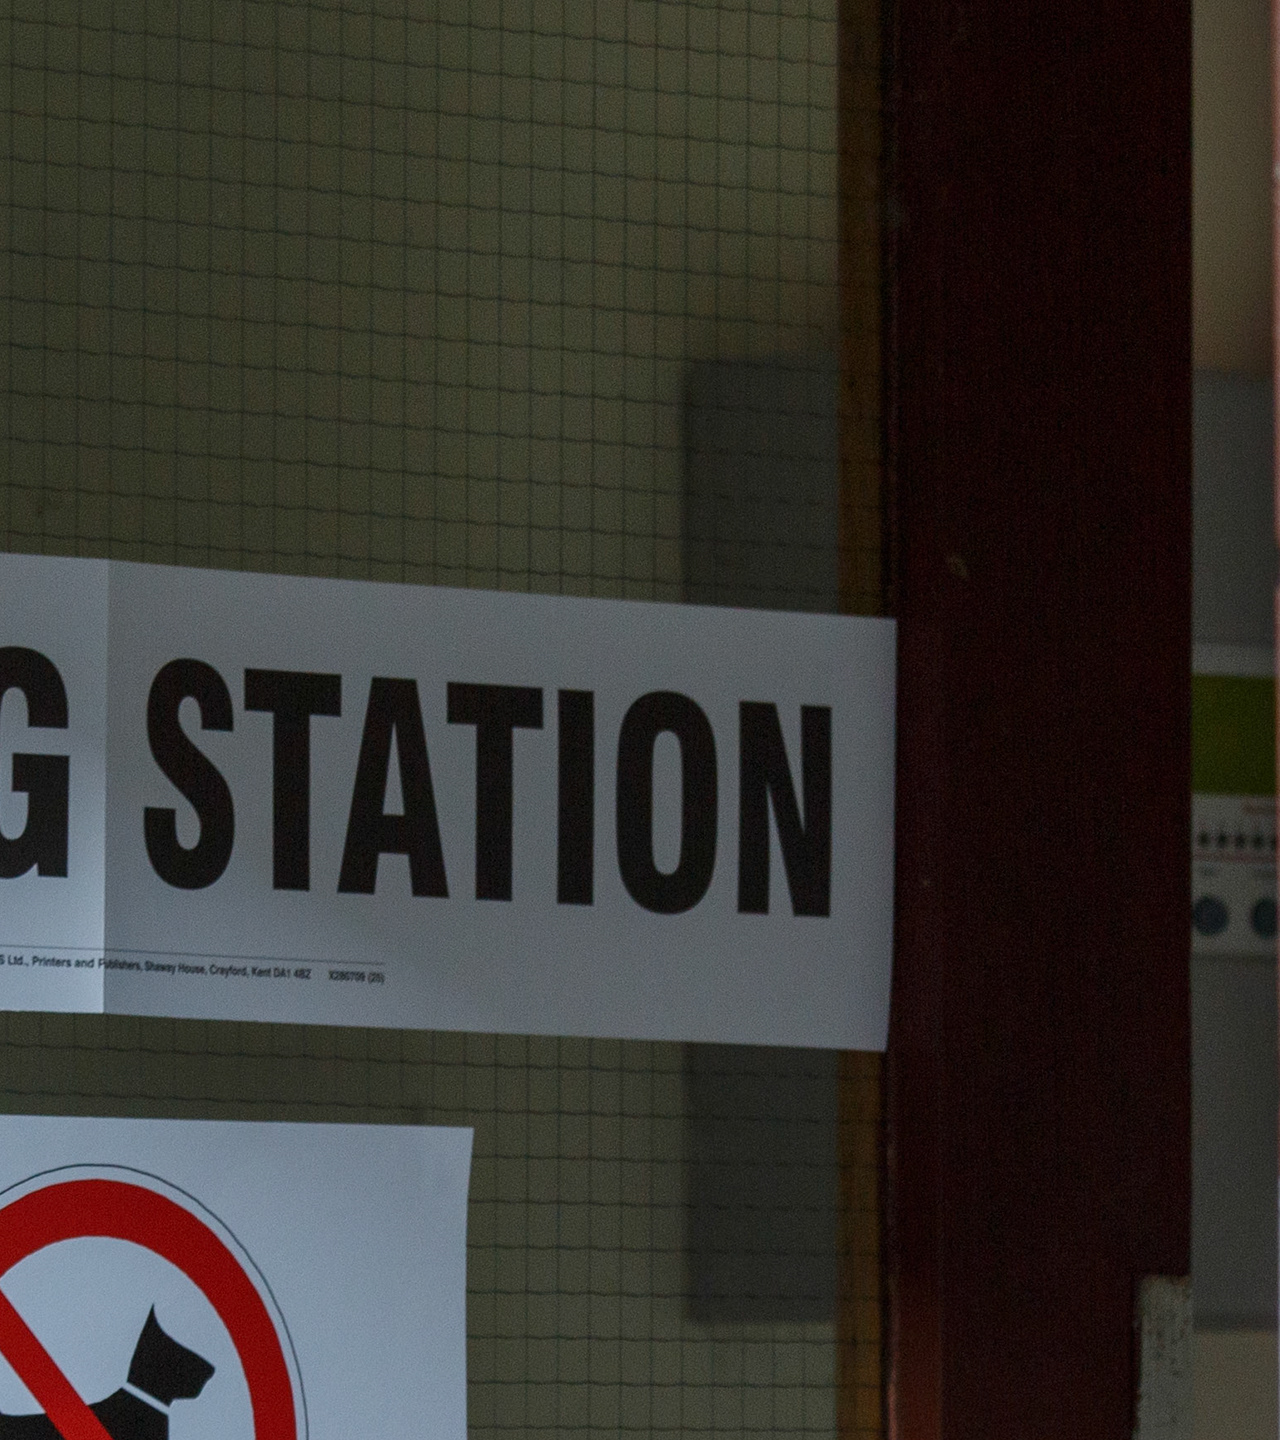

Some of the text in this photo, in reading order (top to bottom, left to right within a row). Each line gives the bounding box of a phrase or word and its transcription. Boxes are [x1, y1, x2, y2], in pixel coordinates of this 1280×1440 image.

[143, 657, 833, 919] STATION
[32, 956, 72, 968] Printers
[74, 958, 95, 968] and
[251, 966, 271, 977] Kent
[273, 967, 291, 978] DA1
